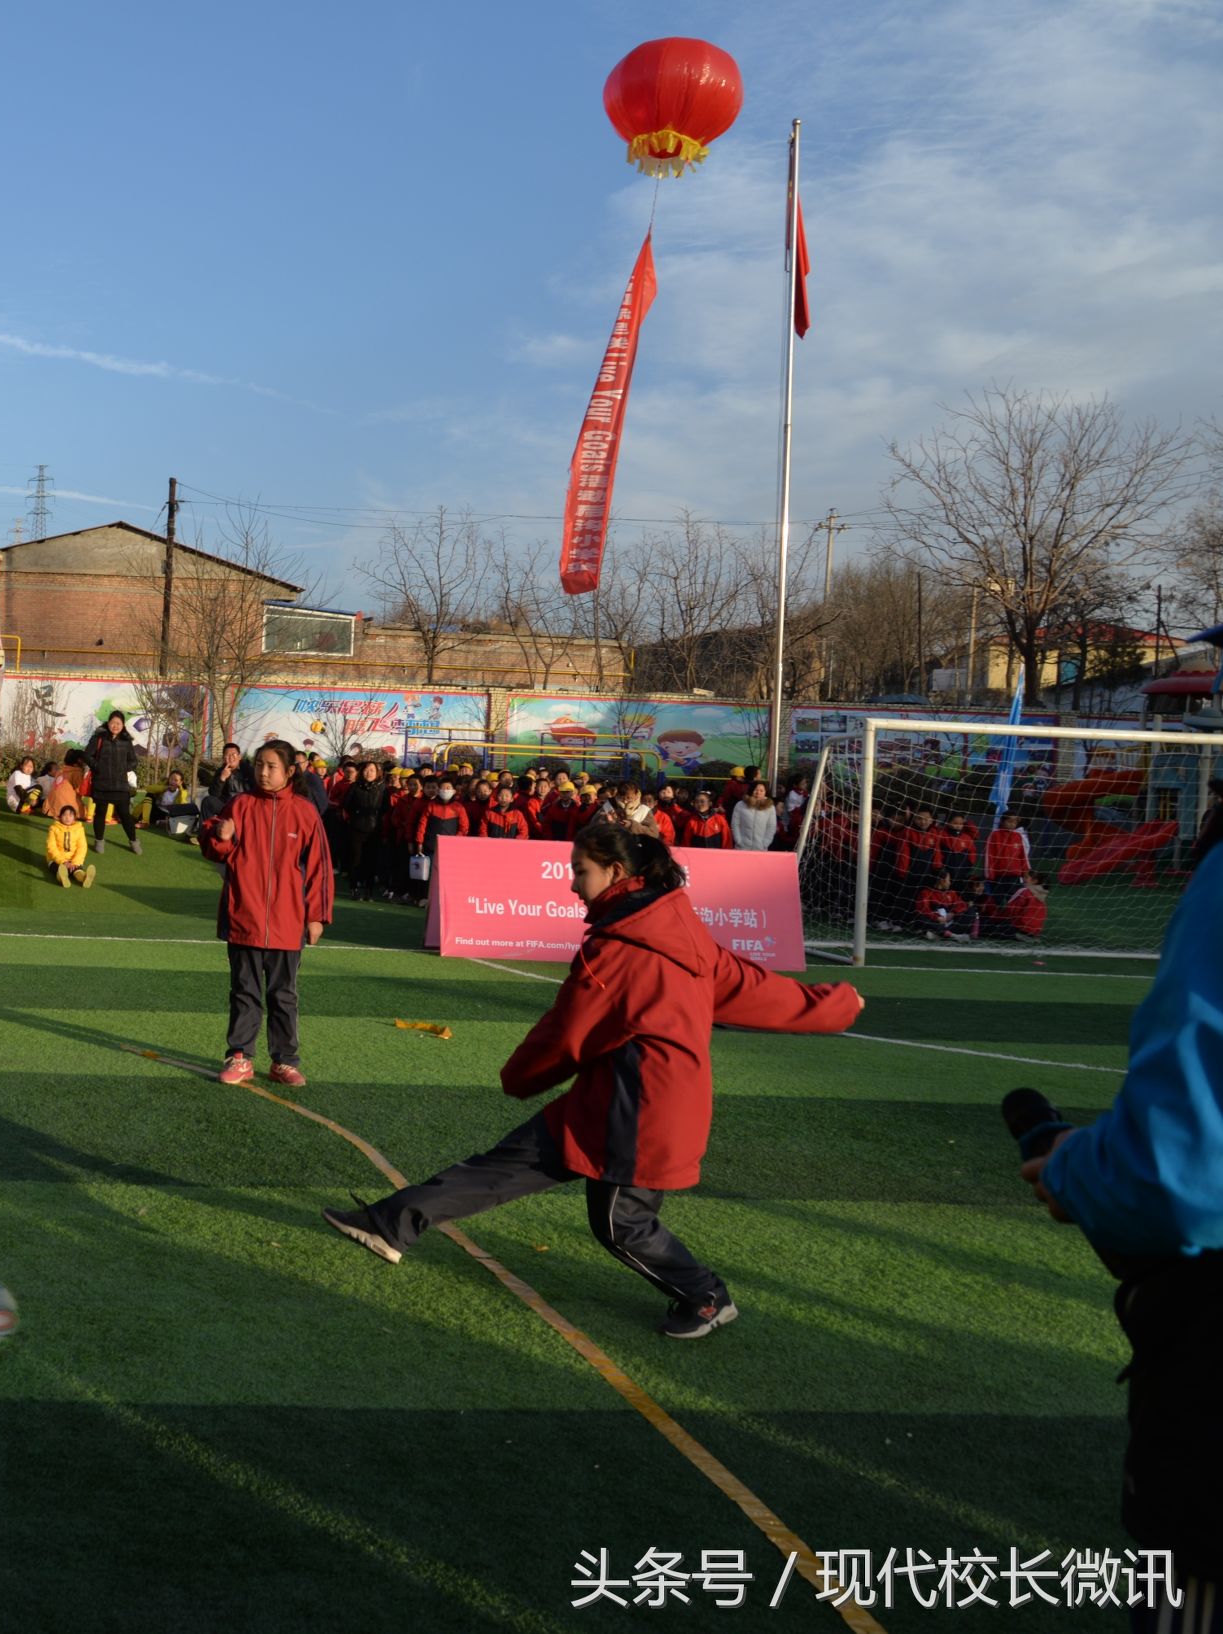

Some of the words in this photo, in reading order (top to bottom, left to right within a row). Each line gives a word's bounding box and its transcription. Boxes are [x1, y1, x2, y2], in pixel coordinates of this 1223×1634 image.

[585, 389, 623, 423] Your
[580, 429, 617, 472] Goals
[541, 860, 575, 881] 201
[508, 899, 542, 917] Your
[455, 936, 474, 946] Find
[475, 938, 490, 947] out
[491, 939, 514, 948] more
[515, 940, 525, 948] at
[731, 938, 765, 951] FIFA
